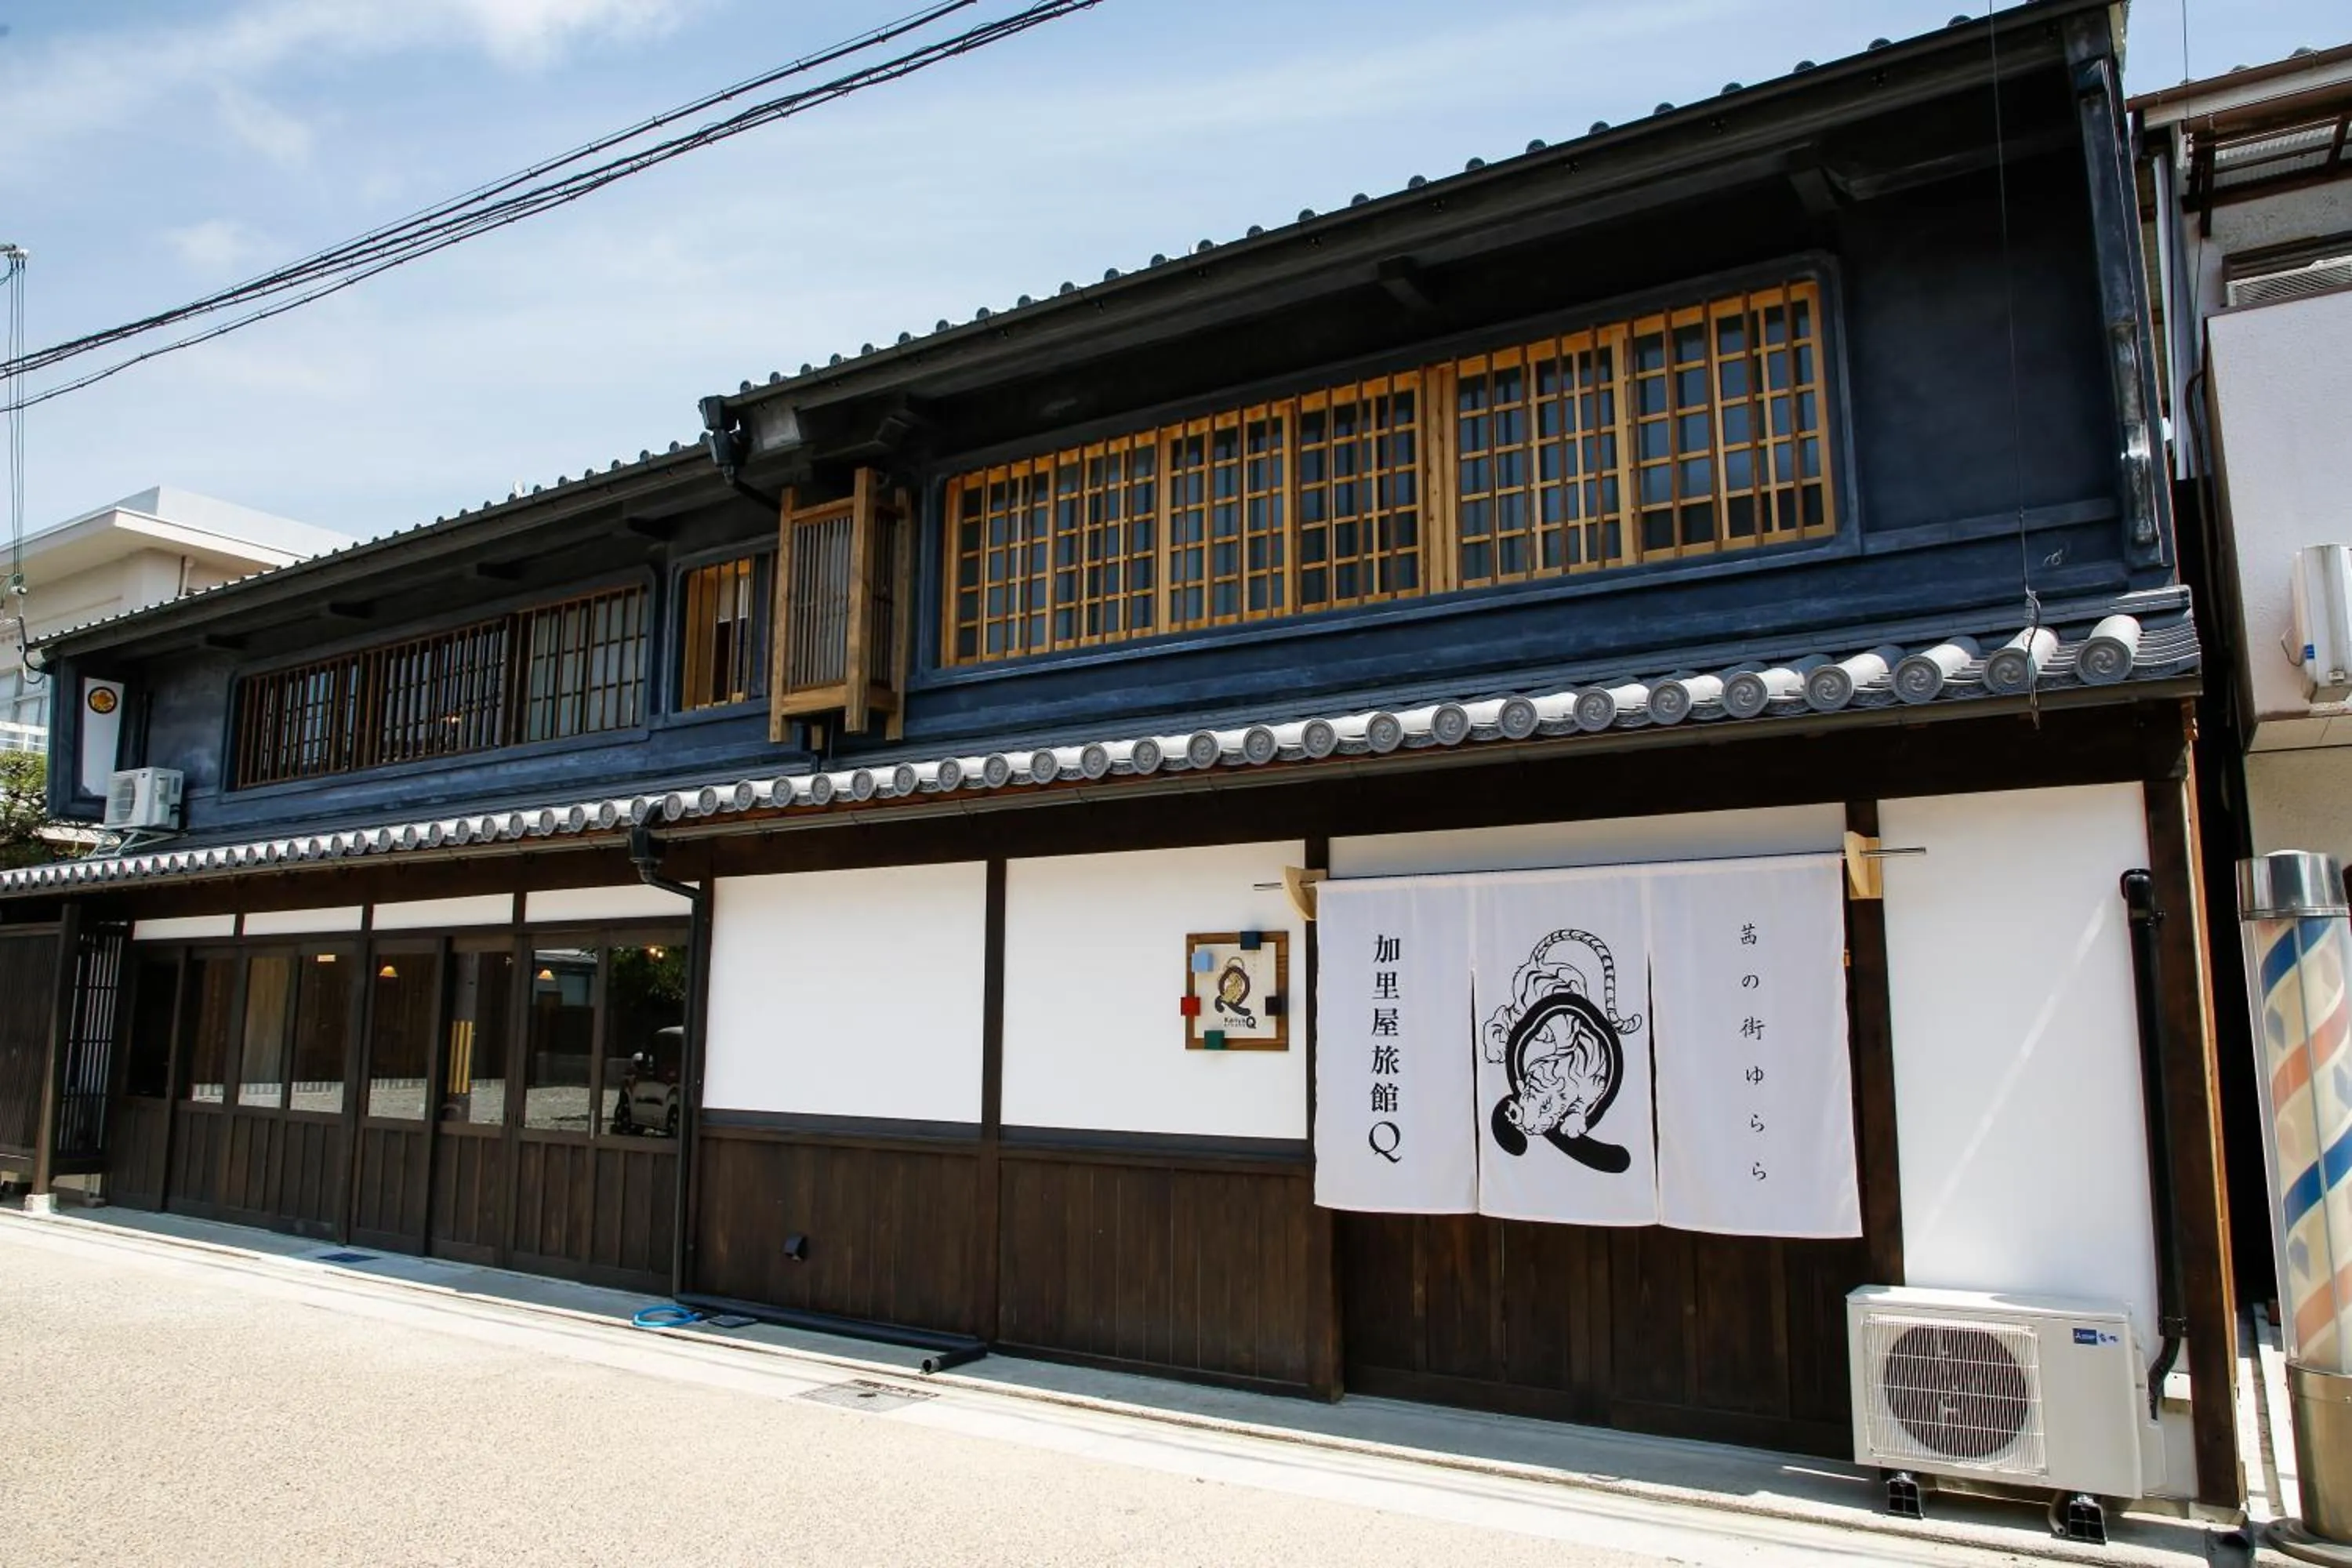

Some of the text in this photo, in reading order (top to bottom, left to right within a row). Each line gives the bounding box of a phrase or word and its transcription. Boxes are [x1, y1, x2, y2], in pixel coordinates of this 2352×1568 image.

[1368, 934, 1402, 1164] 加里屋旅館Q
[1740, 923, 1767, 1181] 茜の街ゆらら
